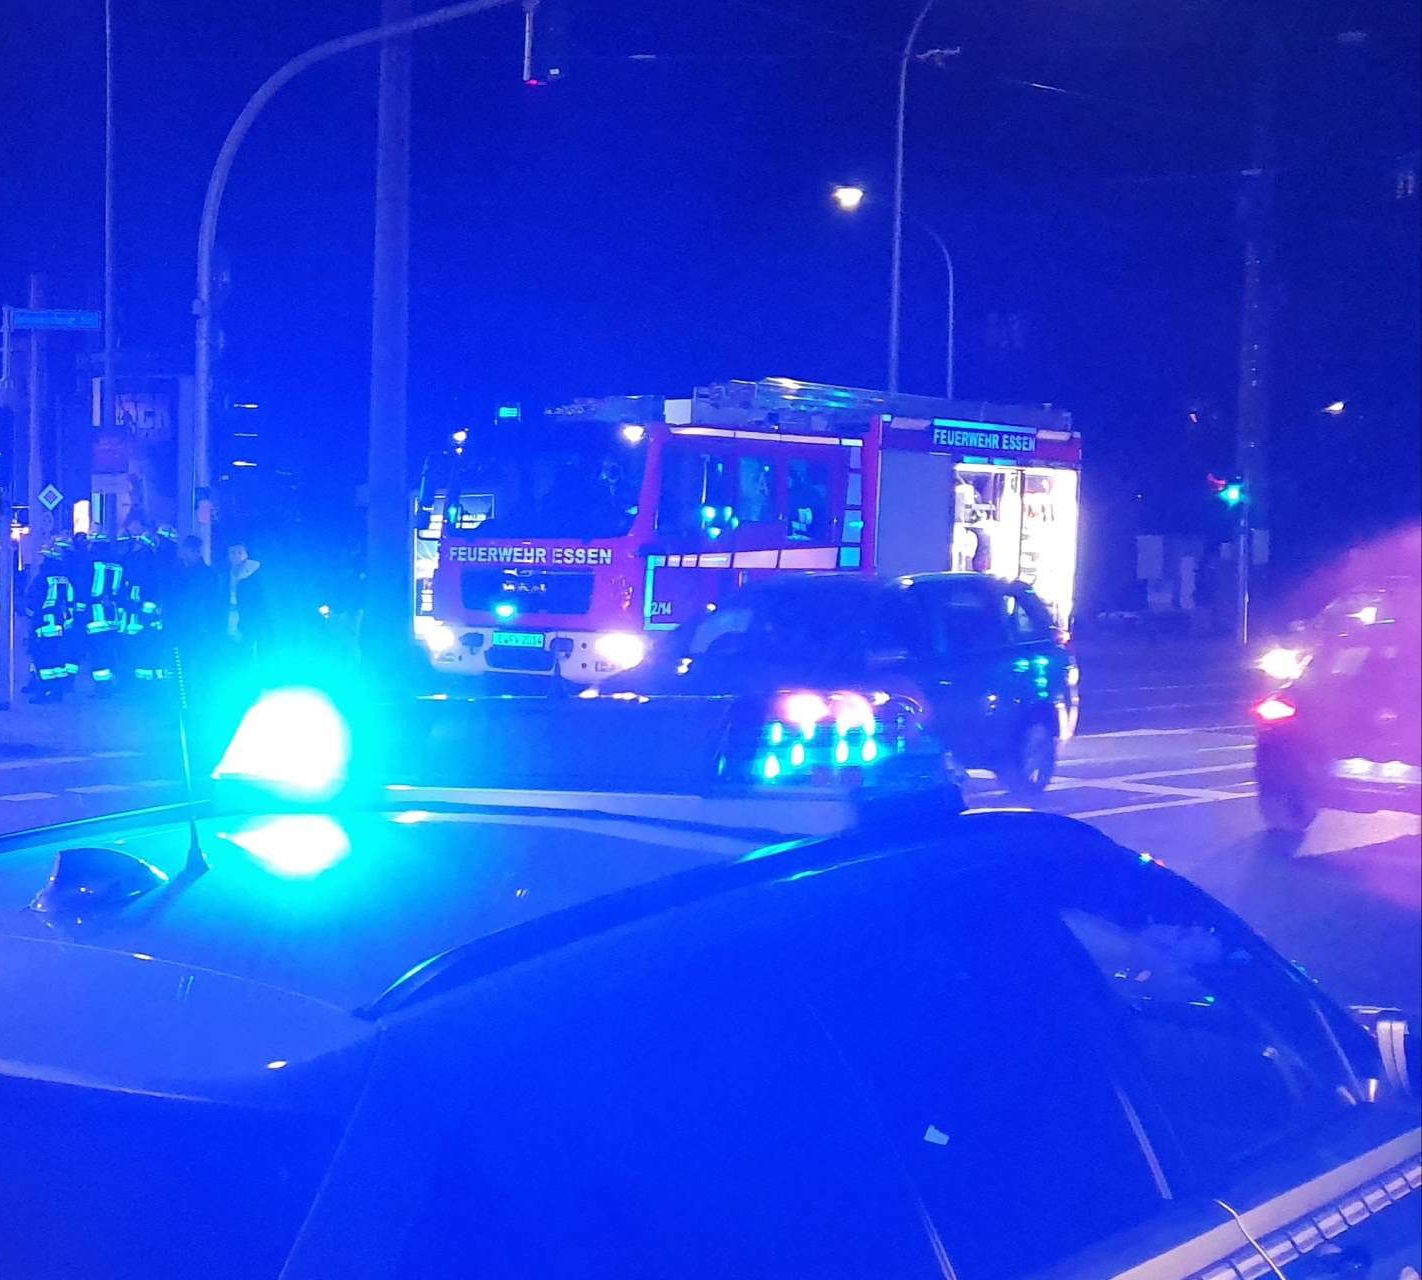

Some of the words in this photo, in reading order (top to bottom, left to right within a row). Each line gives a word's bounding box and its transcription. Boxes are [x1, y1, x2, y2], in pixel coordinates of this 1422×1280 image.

[933, 429, 999, 449] FEUERWEHR
[1002, 434, 1035, 452] ESSEN
[449, 547, 546, 563] FEUERWEHR
[552, 548, 611, 564] ESSEN
